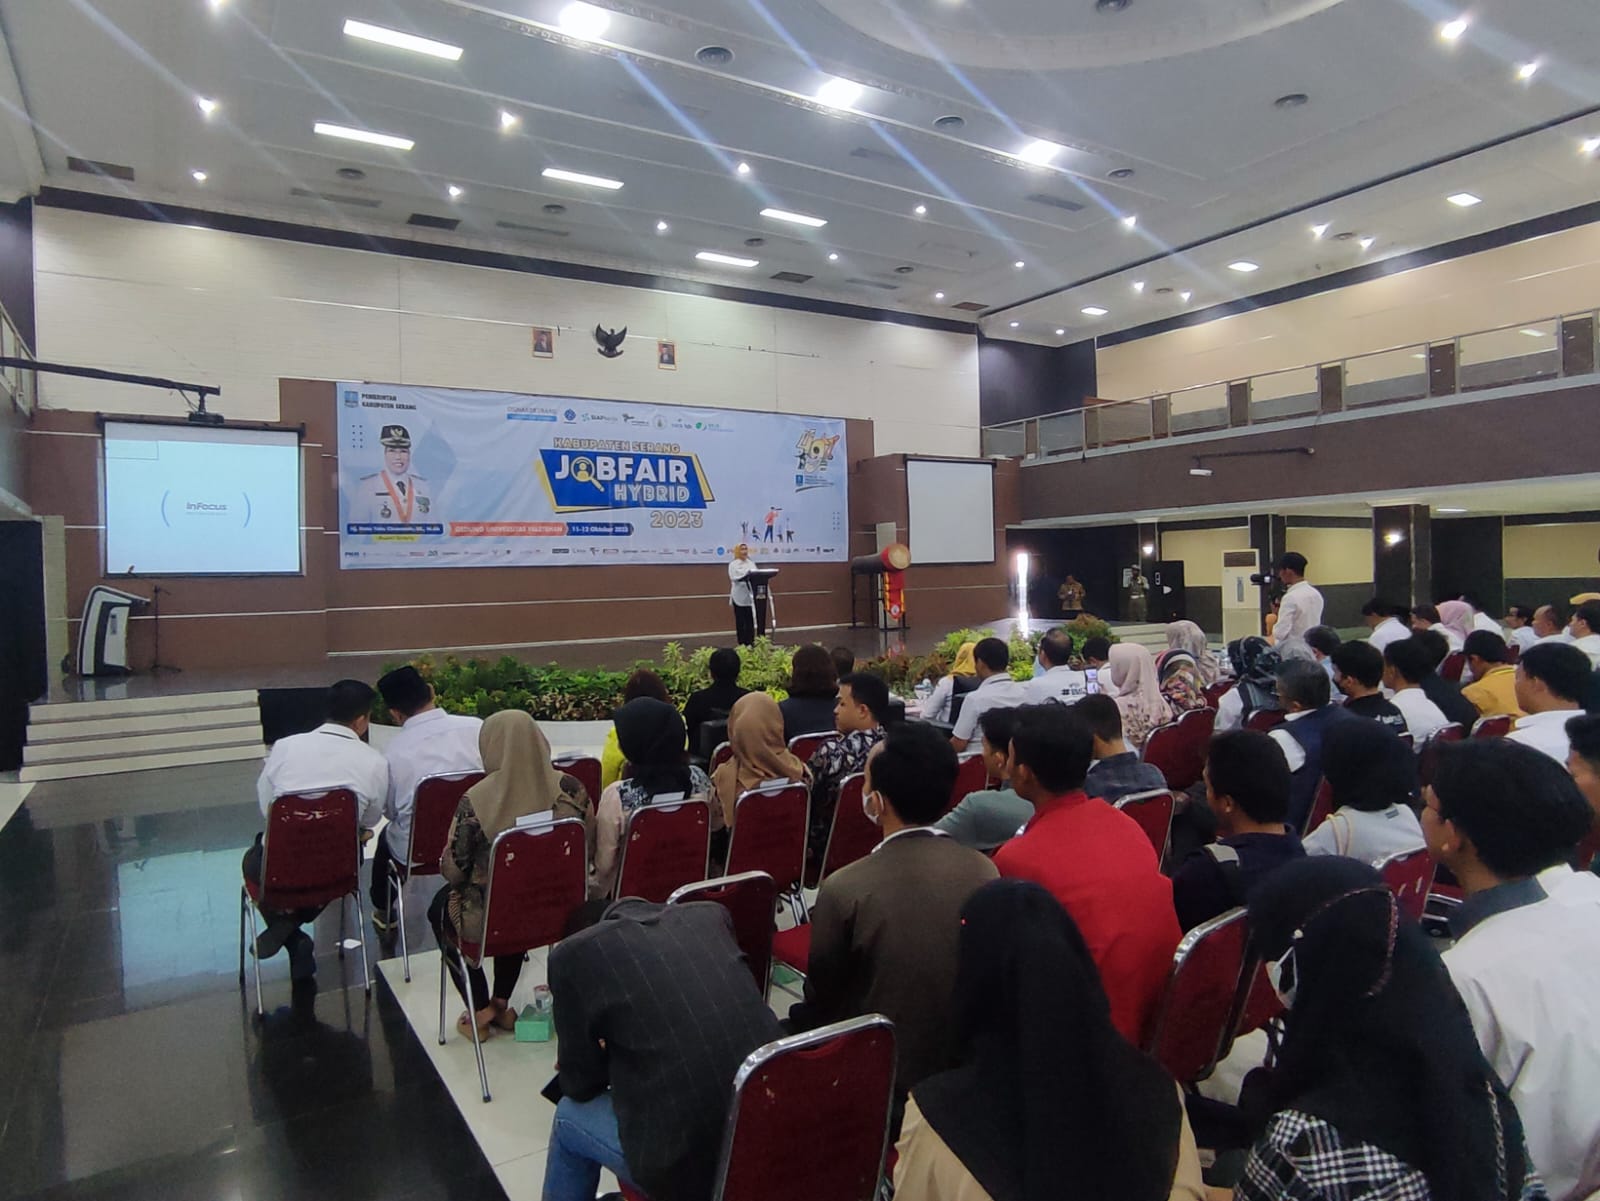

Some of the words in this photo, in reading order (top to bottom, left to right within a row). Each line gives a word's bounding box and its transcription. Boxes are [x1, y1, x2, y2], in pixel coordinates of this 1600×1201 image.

[553, 437, 631, 452] KABUPATEN
[632, 440, 681, 455] SERANG
[555, 454, 688, 484] JOBFAIR
[614, 484, 690, 503] HYBRID
[571, 525, 589, 533] 11-12
[650, 510, 704, 529] 2023
